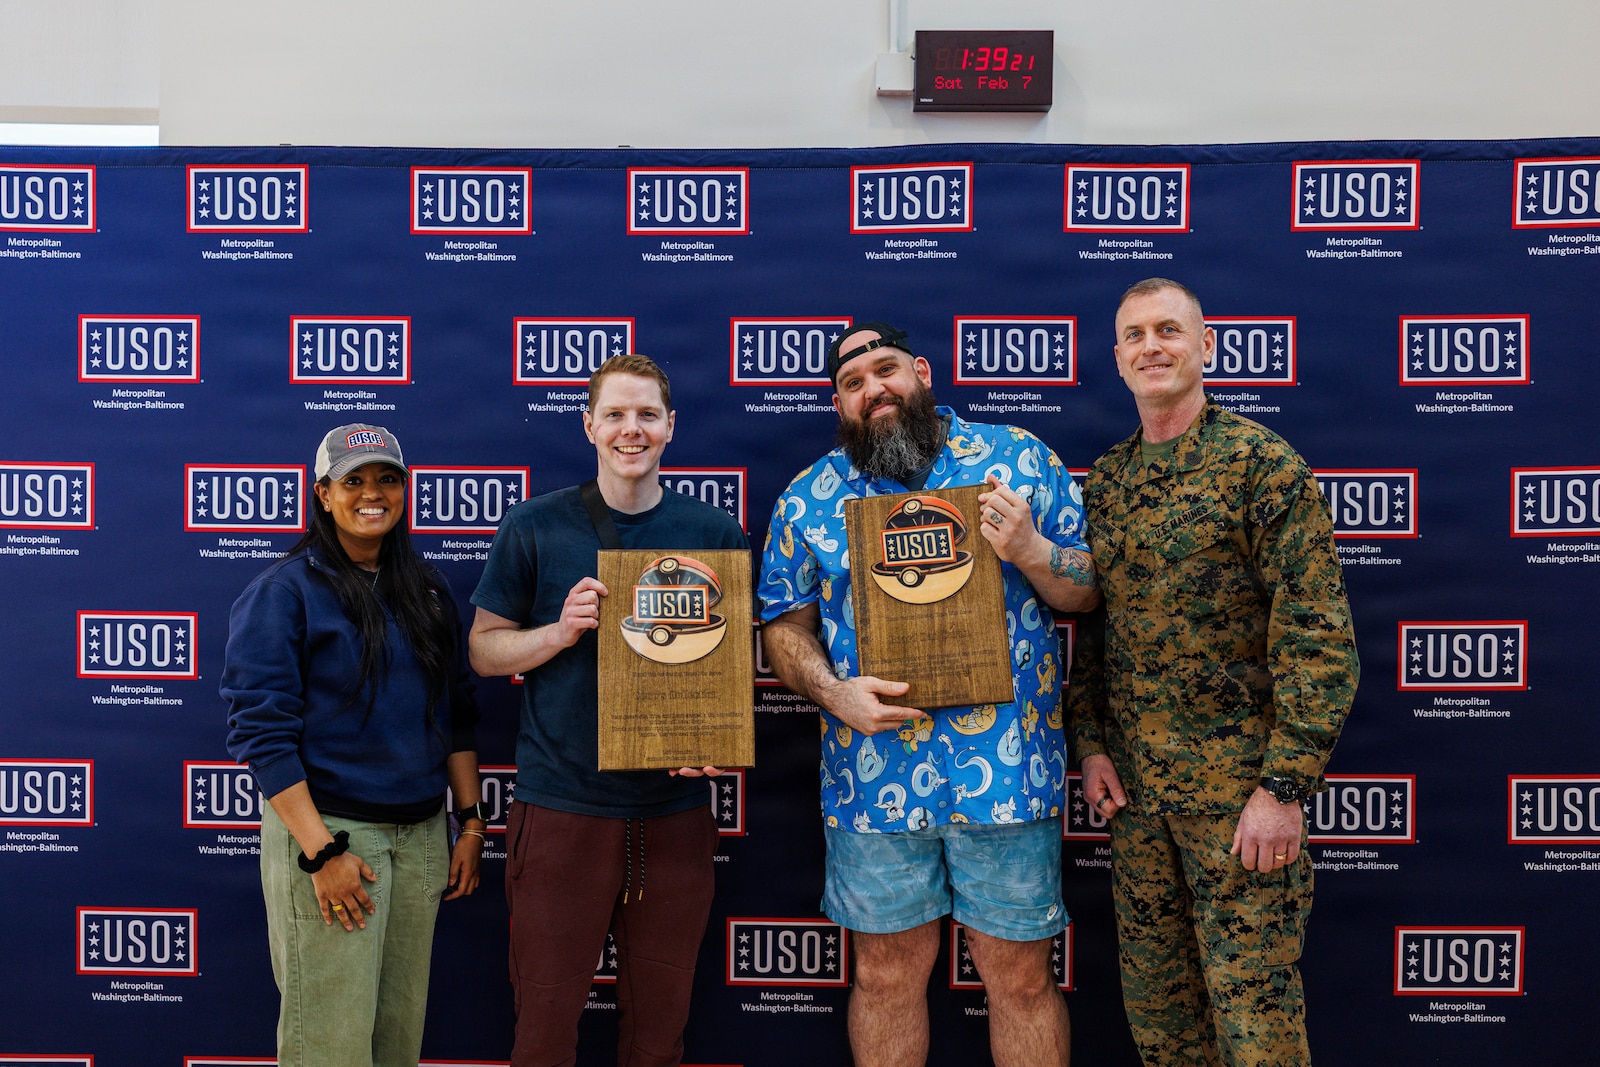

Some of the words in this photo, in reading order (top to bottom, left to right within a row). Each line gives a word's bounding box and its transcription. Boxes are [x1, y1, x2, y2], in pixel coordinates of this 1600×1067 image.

[961, 47, 1009, 71] 1:39
[1010, 54, 1035, 71] 21
[934, 76, 963, 90] Sat
[977, 76, 1009, 90] Feb
[1021, 76, 1033, 90] 7
[1320, 173, 1390, 218] USO
[1543, 169, 1600, 215] US
[1, 176, 68, 220] USO
[214, 177, 281, 220] USO
[438, 179, 504, 222] USO
[655, 179, 721, 223] USO
[878, 175, 945, 220] USO
[1092, 176, 1161, 220] USO
[8, 238, 61, 248] Metropolitan
[1326, 237, 1382, 247] Metropolitan
[1549, 233, 1600, 244] Metropolita
[221, 239, 274, 249] Metropolitan
[444, 241, 497, 251] Metropolitan
[661, 241, 714, 251] Metropolitan
[885, 239, 938, 249] Metropolitan
[1098, 239, 1153, 249] Metropolitan
[0, 249, 81, 259] ashington-Baltimore
[865, 250, 957, 261] Washington-Baltimore
[1306, 249, 1402, 259] Washington-Baltimore
[1528, 245, 1600, 256] Washington-Balt
[202, 251, 293, 261] Washington-Baltimore
[425, 252, 516, 262] Washington-Baltimore
[642, 253, 733, 263] Washington-Baltimore
[1079, 251, 1173, 261] Washington-Baltimore
[106, 327, 172, 371] USO
[317, 328, 383, 372] USO
[541, 330, 607, 373] USO
[758, 329, 825, 373] USO
[982, 328, 1049, 372] USO
[1429, 328, 1499, 372] USO
[112, 389, 165, 399] Metropolitan
[324, 390, 376, 400] Metropolitan
[547, 391, 589, 401] Metropolit
[764, 392, 817, 402] Metropolitan
[988, 392, 1042, 402] Metropolitan
[1212, 392, 1260, 402] etropolitan
[1436, 392, 1492, 402] Metropolitan
[93, 400, 184, 410] Washington-Baltimore
[304, 402, 395, 412] Washington-Baltimore
[528, 403, 589, 413] Washington-Ba
[745, 403, 836, 414] Washington-Baltimore
[968, 403, 1061, 413] Washington-Baltimore
[1220, 404, 1280, 413] ton-Baltimore
[1415, 403, 1513, 414] Washington-Baltimore
[354, 432, 377, 444] USO
[1, 473, 67, 517] USO
[212, 476, 278, 520] USO
[436, 478, 502, 522] USO
[1154, 525, 1170, 539] U.S.
[1170, 504, 1208, 531] MARINES
[7, 535, 60, 545] Metropolitan
[219, 538, 271, 548] Metropolitan
[896, 531, 938, 559] USO
[1336, 545, 1381, 555] etropolitan
[1547, 542, 1600, 552] Metropolita
[423, 551, 488, 561] Washington-Bal
[1526, 554, 1600, 565] Washington-Balt
[650, 592, 691, 618] USO
[104, 623, 170, 667] USO
[1427, 634, 1498, 678] USO
[111, 685, 163, 695] Metropolitan
[92, 696, 183, 706] Washington-Baltimore
[1434, 697, 1490, 707] Metropolitan
[1413, 709, 1510, 719] Washington-Baltimore
[0, 771, 66, 814] USO
[211, 774, 264, 816] US
[1316, 787, 1386, 830] USO
[7, 832, 59, 842] Metropolitan
[217, 835, 261, 845] Metropolit
[0, 843, 79, 853] shington-Baltimore
[198, 846, 261, 856] Washington-Ba
[1323, 850, 1378, 859] Metropolitan
[1312, 861, 1399, 871] ashington-Baltimore
[1524, 862, 1600, 872] Washington-Balti
[104, 919, 170, 963] USO
[754, 930, 820, 973] USO
[1424, 939, 1494, 982] USO
[111, 981, 163, 991] Metropolitan
[92, 992, 183, 1003] Washington-Baltimore
[761, 992, 813, 1002] Metropolitan
[741, 1003, 833, 1013] Washington-Baltimore
[1430, 1002, 1486, 1012] Metropolitan
[1409, 1014, 1506, 1024] Washington-Baltimore
